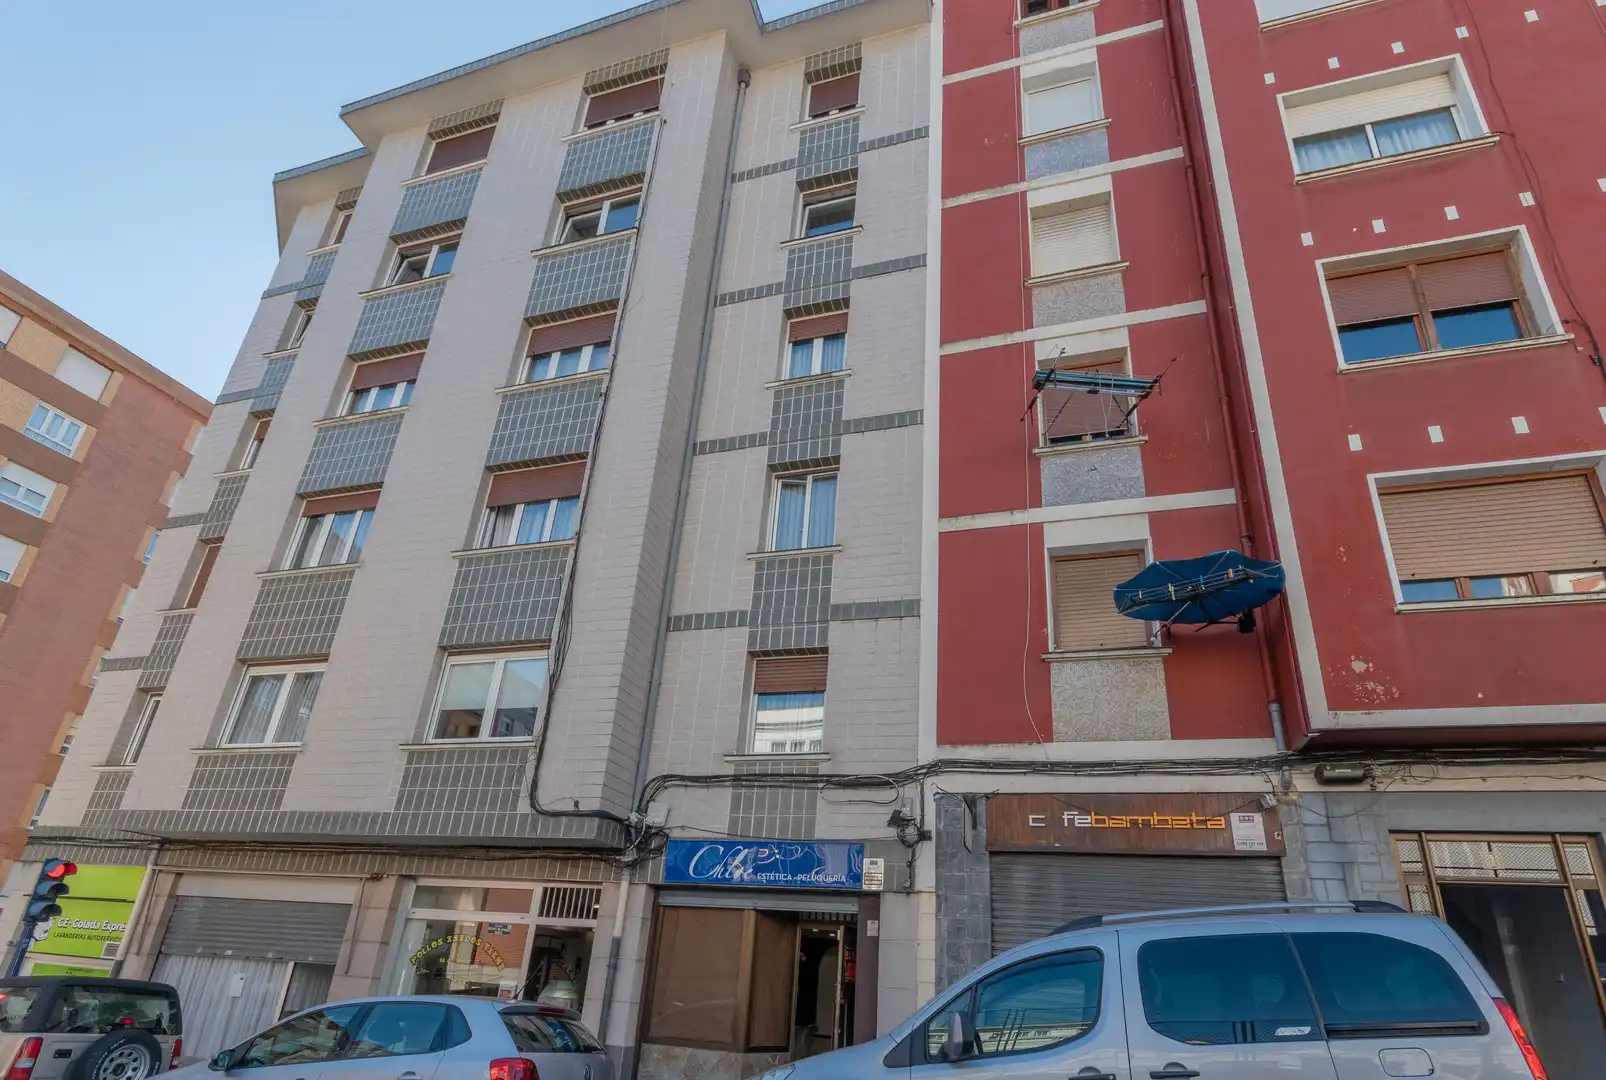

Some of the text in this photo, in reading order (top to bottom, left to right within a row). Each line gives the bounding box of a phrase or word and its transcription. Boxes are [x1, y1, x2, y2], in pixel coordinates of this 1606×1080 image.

[757, 871, 846, 883] ESTÉTICA PELUQUERÍA
[72, 919, 100, 929] Colada
[410, 938, 444, 966] POLLOS
